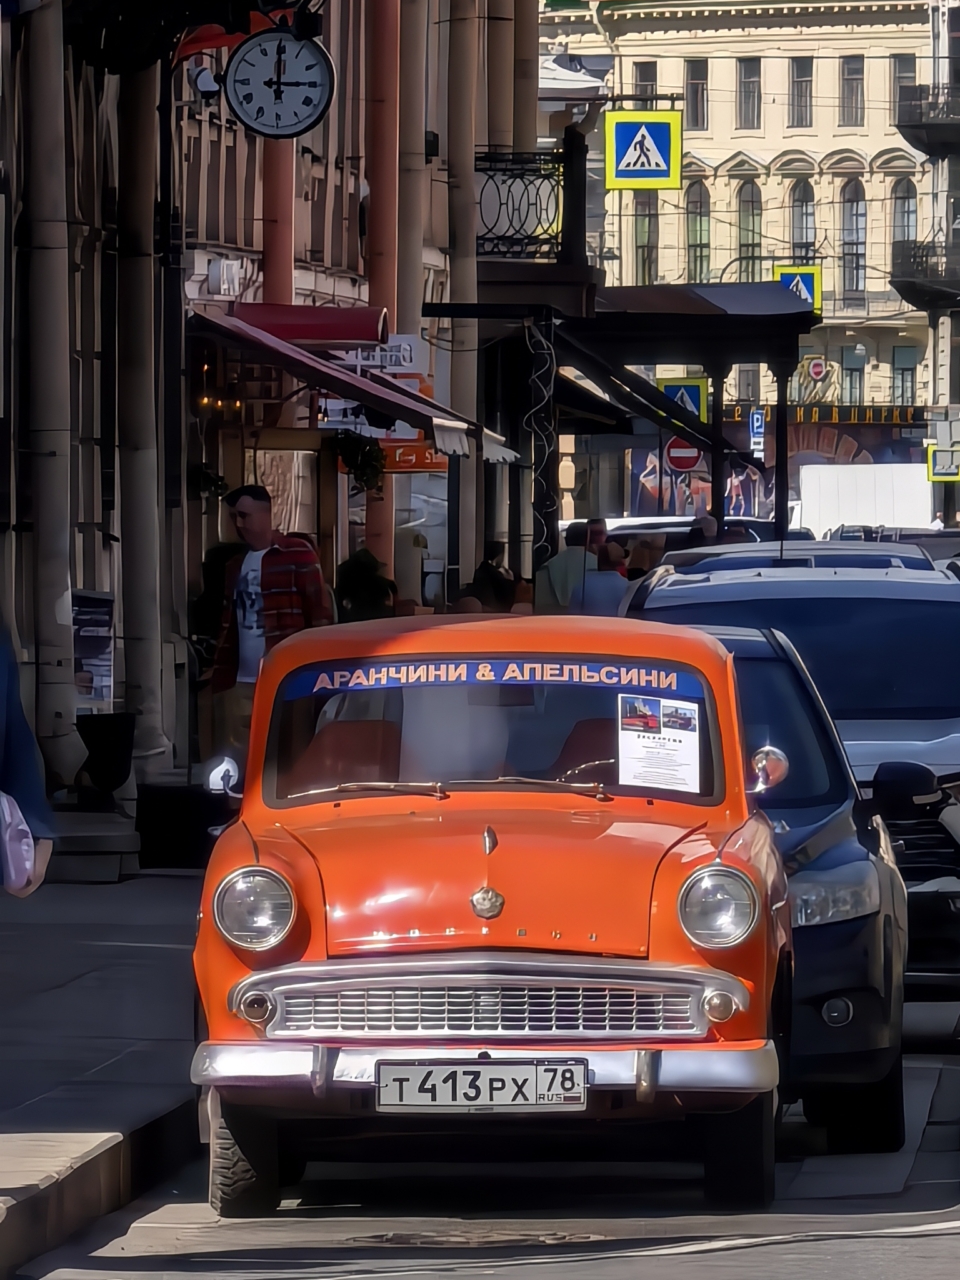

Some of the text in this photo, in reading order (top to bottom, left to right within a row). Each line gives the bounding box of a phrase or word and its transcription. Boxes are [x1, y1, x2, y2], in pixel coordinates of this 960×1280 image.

[312, 662, 677, 693] АРАНЧИНИ & АПЕЛЬСИНИ
[543, 1067, 576, 1093] 78
[537, 1093, 563, 1103] RUS
